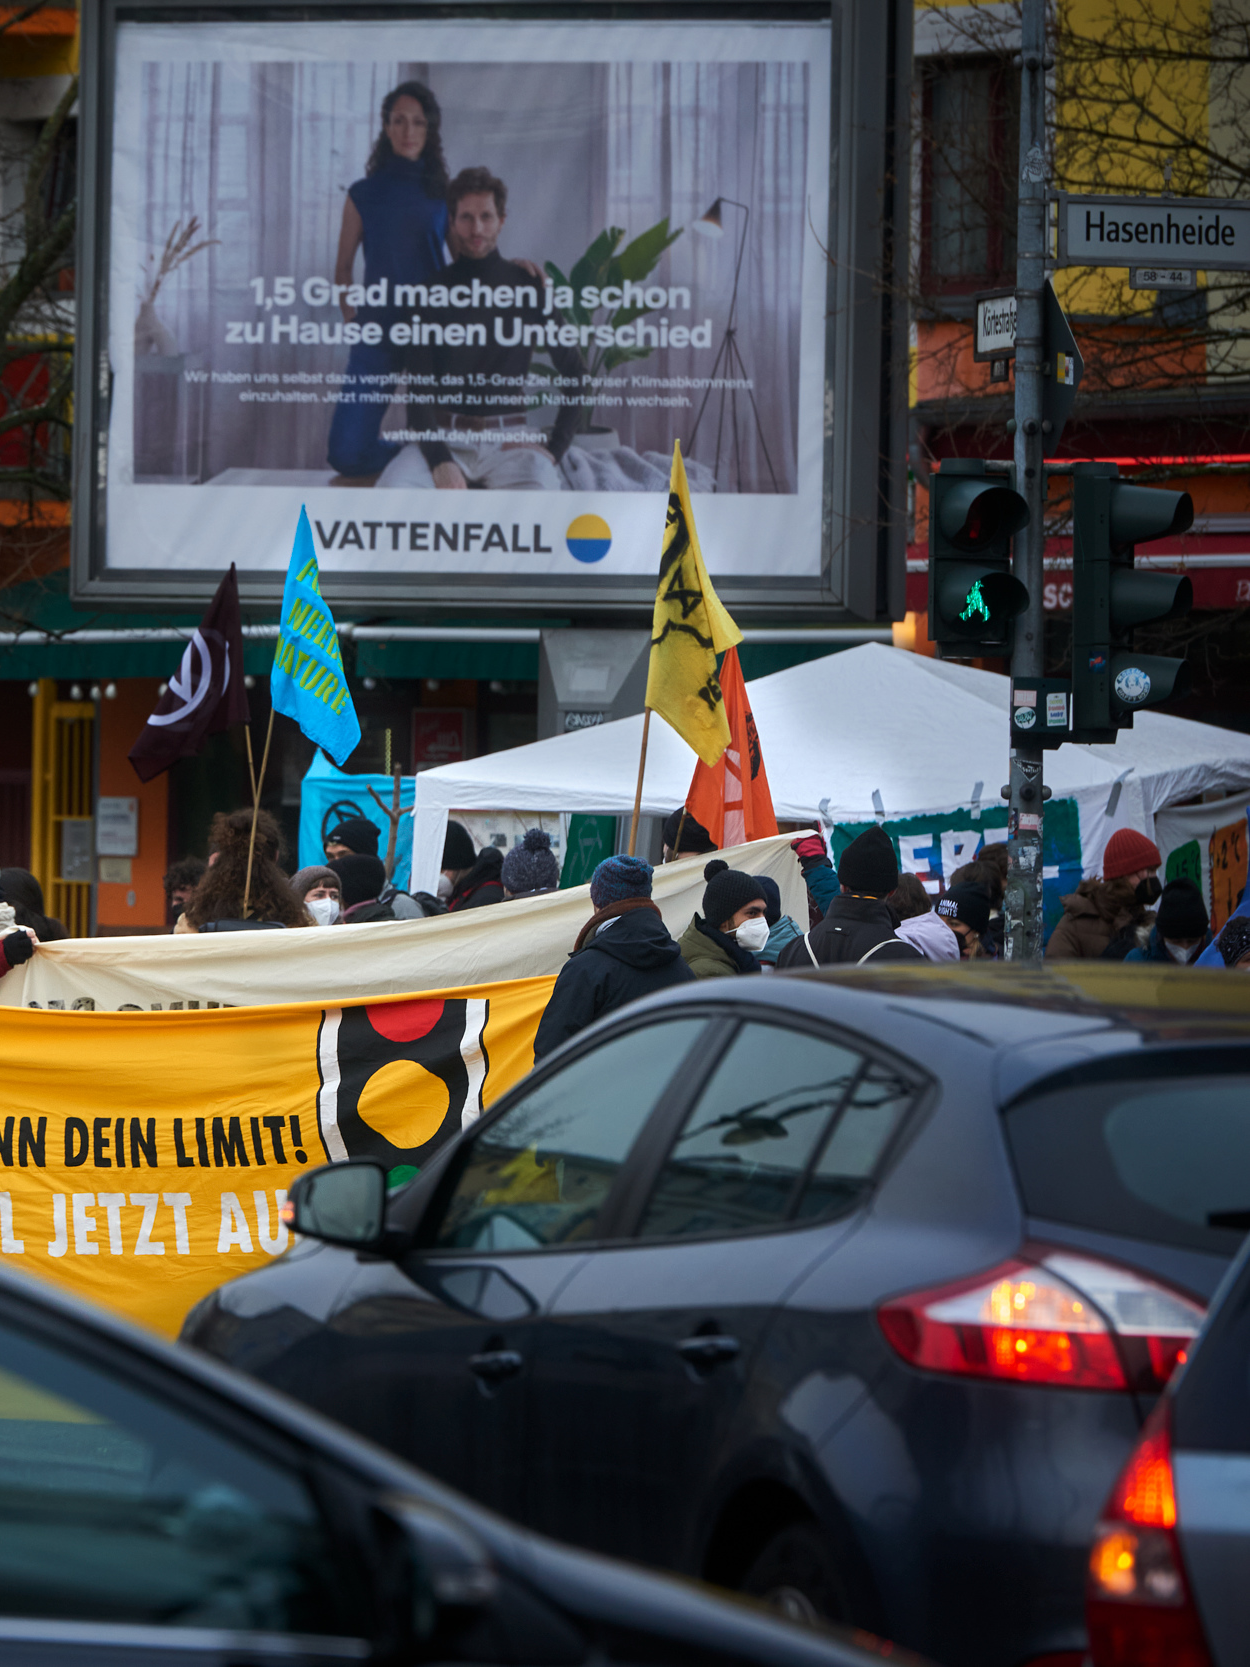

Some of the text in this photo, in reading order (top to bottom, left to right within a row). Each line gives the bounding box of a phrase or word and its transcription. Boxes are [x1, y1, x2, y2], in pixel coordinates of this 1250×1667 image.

[1085, 211, 1235, 246] Hasenheide
[1143, 272, 1157, 282] 58
[1169, 272, 1183, 282] 44
[251, 277, 691, 314] 1,5 Grad machen ja schon
[225, 315, 712, 349] zu Hause einen Unterschied
[184, 371, 209, 383] Wir
[212, 371, 251, 384] haben
[254, 374, 280, 384] uns
[282, 371, 324, 385] selbst
[325, 372, 357, 385] dazu
[359, 372, 439, 388] verpflichtet,
[441, 373, 464, 386] das
[553, 374, 579, 387] des
[582, 374, 628, 388] Pariser
[631, 375, 754, 389] Klimaabkommens
[239, 389, 693, 408] einzuhalten. Jetzt mitmachen und zu unseren Naturtarifen wechseln.
[382, 428, 548, 445] vattenfall.de/mitmachen
[314, 520, 553, 553] VATTENFALL
[938, 905, 958, 918] RIGHTS
[939, 899, 958, 910] ANIMAL
[64, 1115, 158, 1168] DEIN
[173, 1114, 309, 1168] LIMIT!
[48, 1192, 193, 1257] JETZT
[217, 1189, 302, 1256] AU
